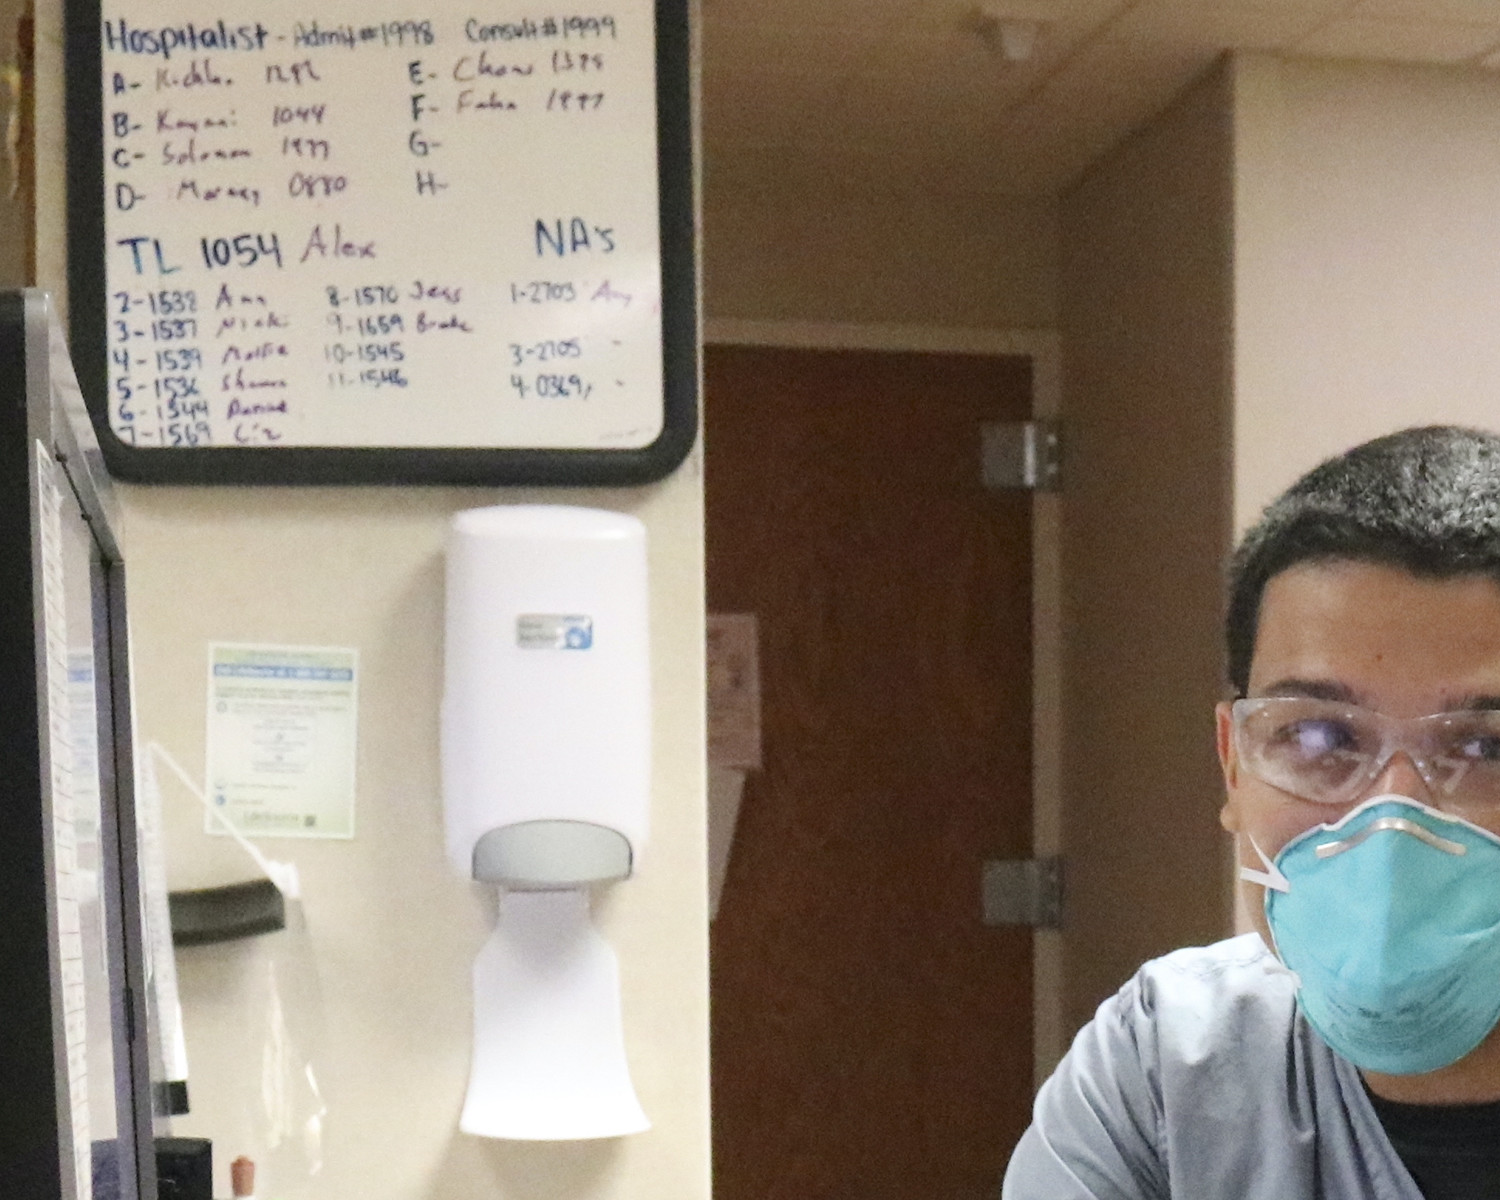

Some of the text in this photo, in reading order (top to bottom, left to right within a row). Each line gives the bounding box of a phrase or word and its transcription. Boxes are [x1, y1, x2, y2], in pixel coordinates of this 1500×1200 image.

[105, 18, 268, 59] Hospitalist
[117, 224, 376, 275] TL 1054 Alex
